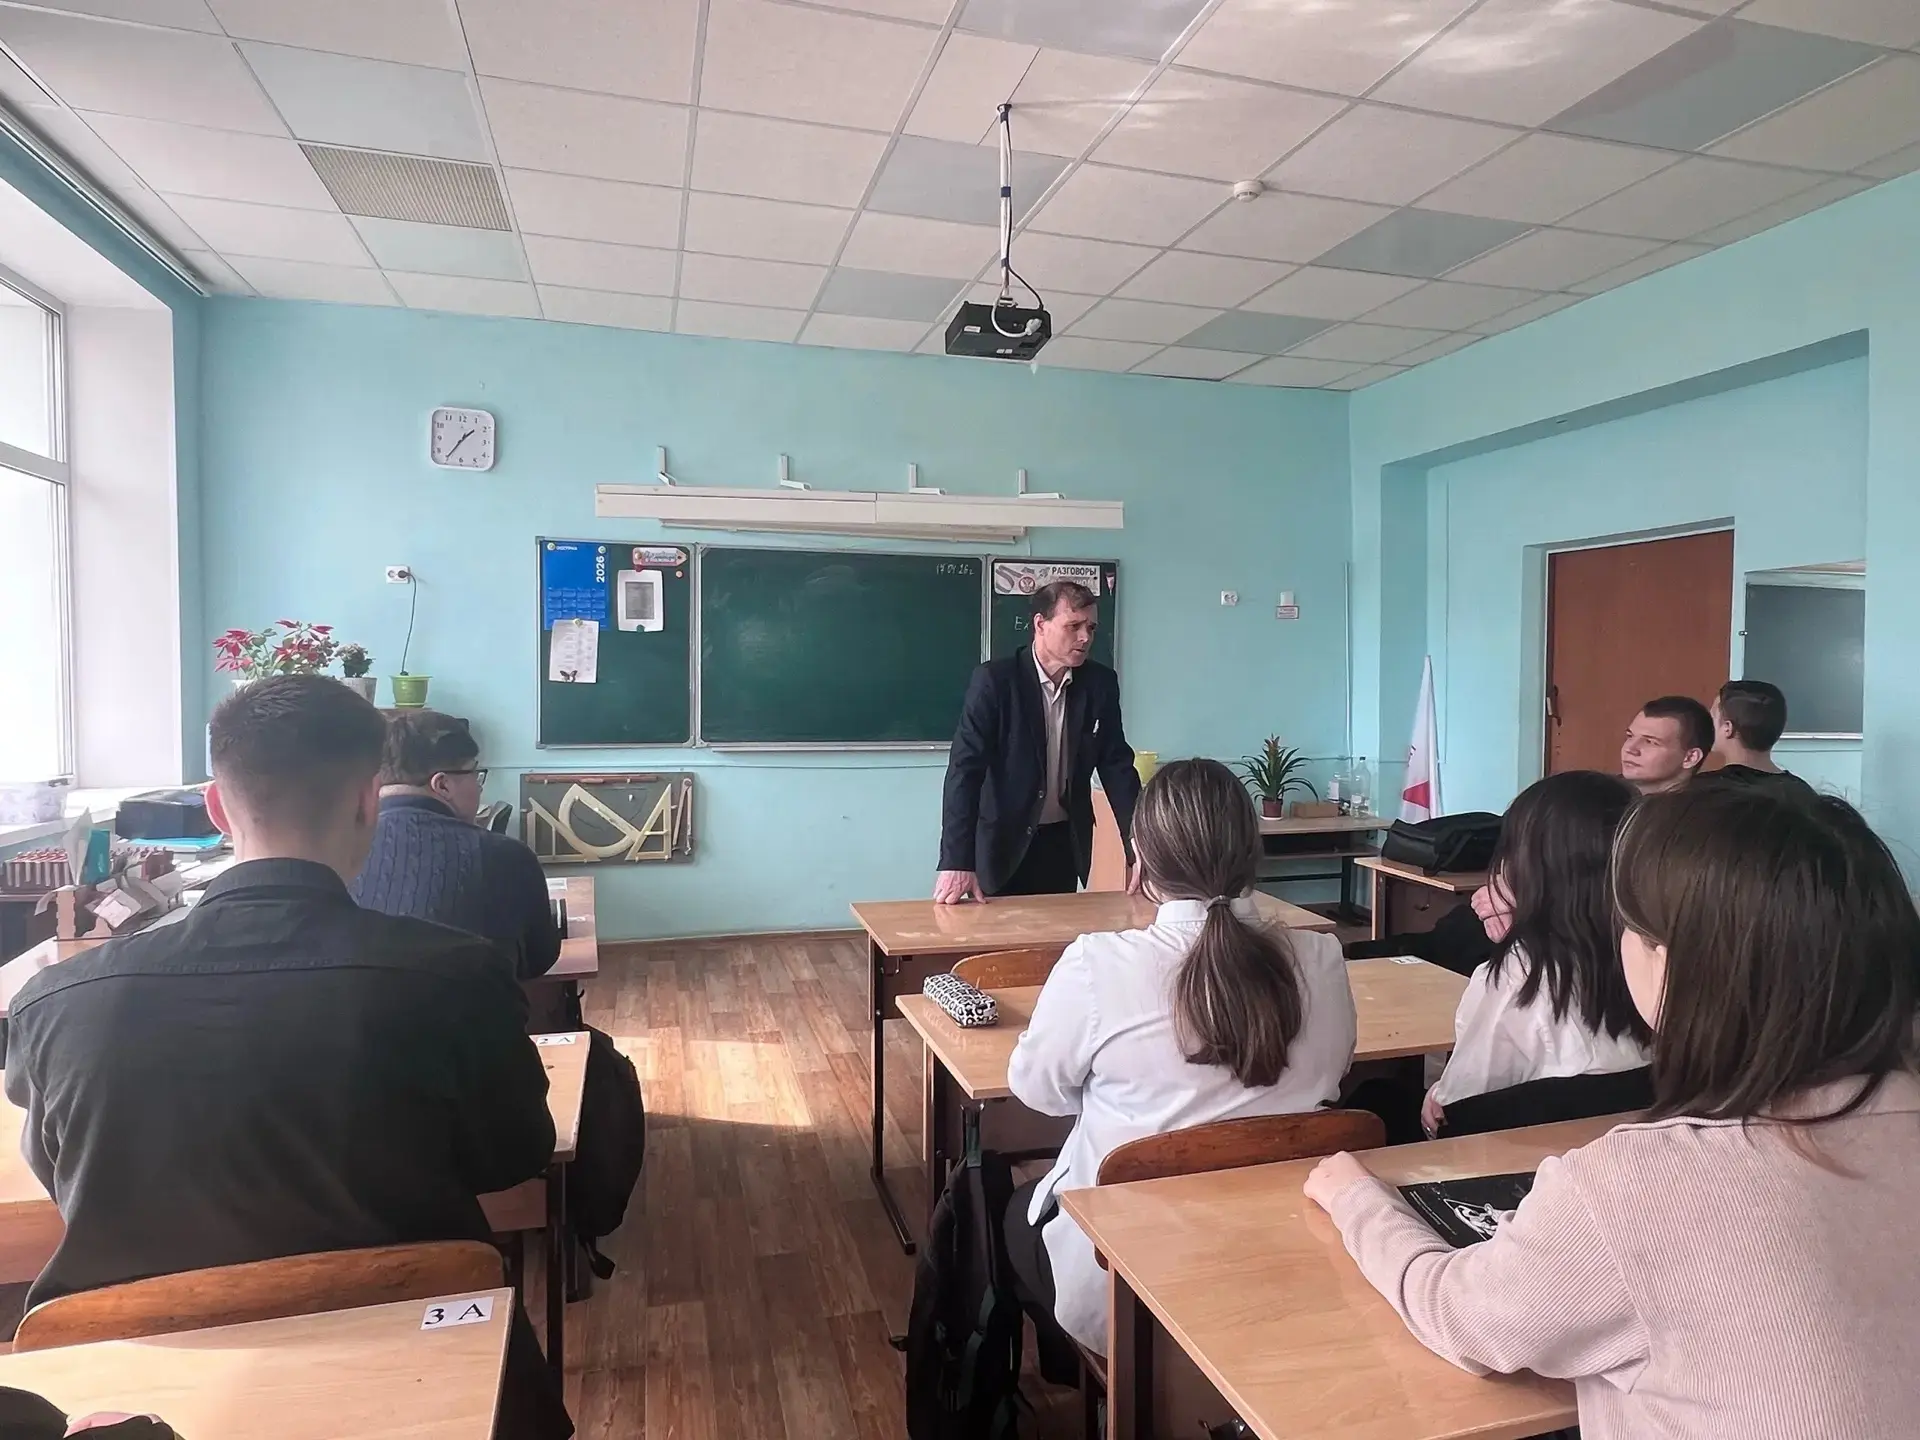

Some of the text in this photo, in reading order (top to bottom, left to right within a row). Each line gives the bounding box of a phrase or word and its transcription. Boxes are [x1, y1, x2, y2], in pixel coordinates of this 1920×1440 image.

[595, 555, 606, 584] 2026
[1051, 566, 1097, 576] РАЗГОВОРЫ
[424, 1302, 486, 1325] 3 А
